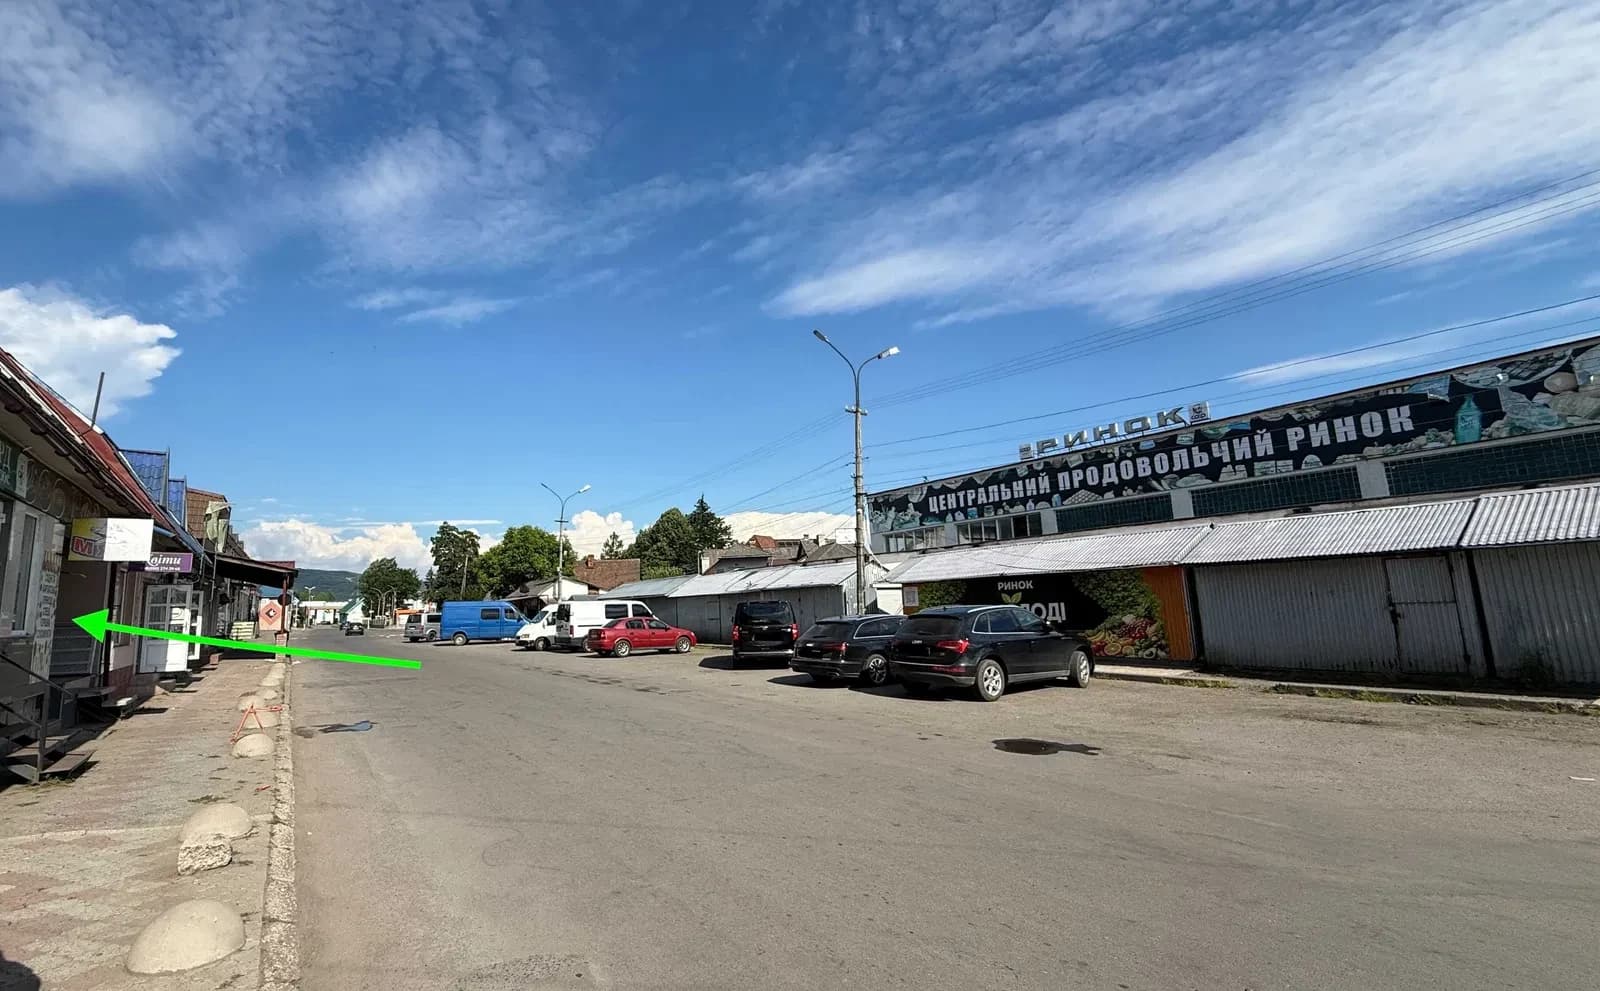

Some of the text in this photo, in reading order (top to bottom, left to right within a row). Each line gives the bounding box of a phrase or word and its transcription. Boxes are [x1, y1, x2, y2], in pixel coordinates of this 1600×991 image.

[1036, 406, 1186, 454] РИНОК
[928, 404, 1415, 514] ЦЕНТРАЛЬНИЙ ПРОДОВОЛЬЧИЙ РИНОК
[997, 580, 1034, 591] РИНОК
